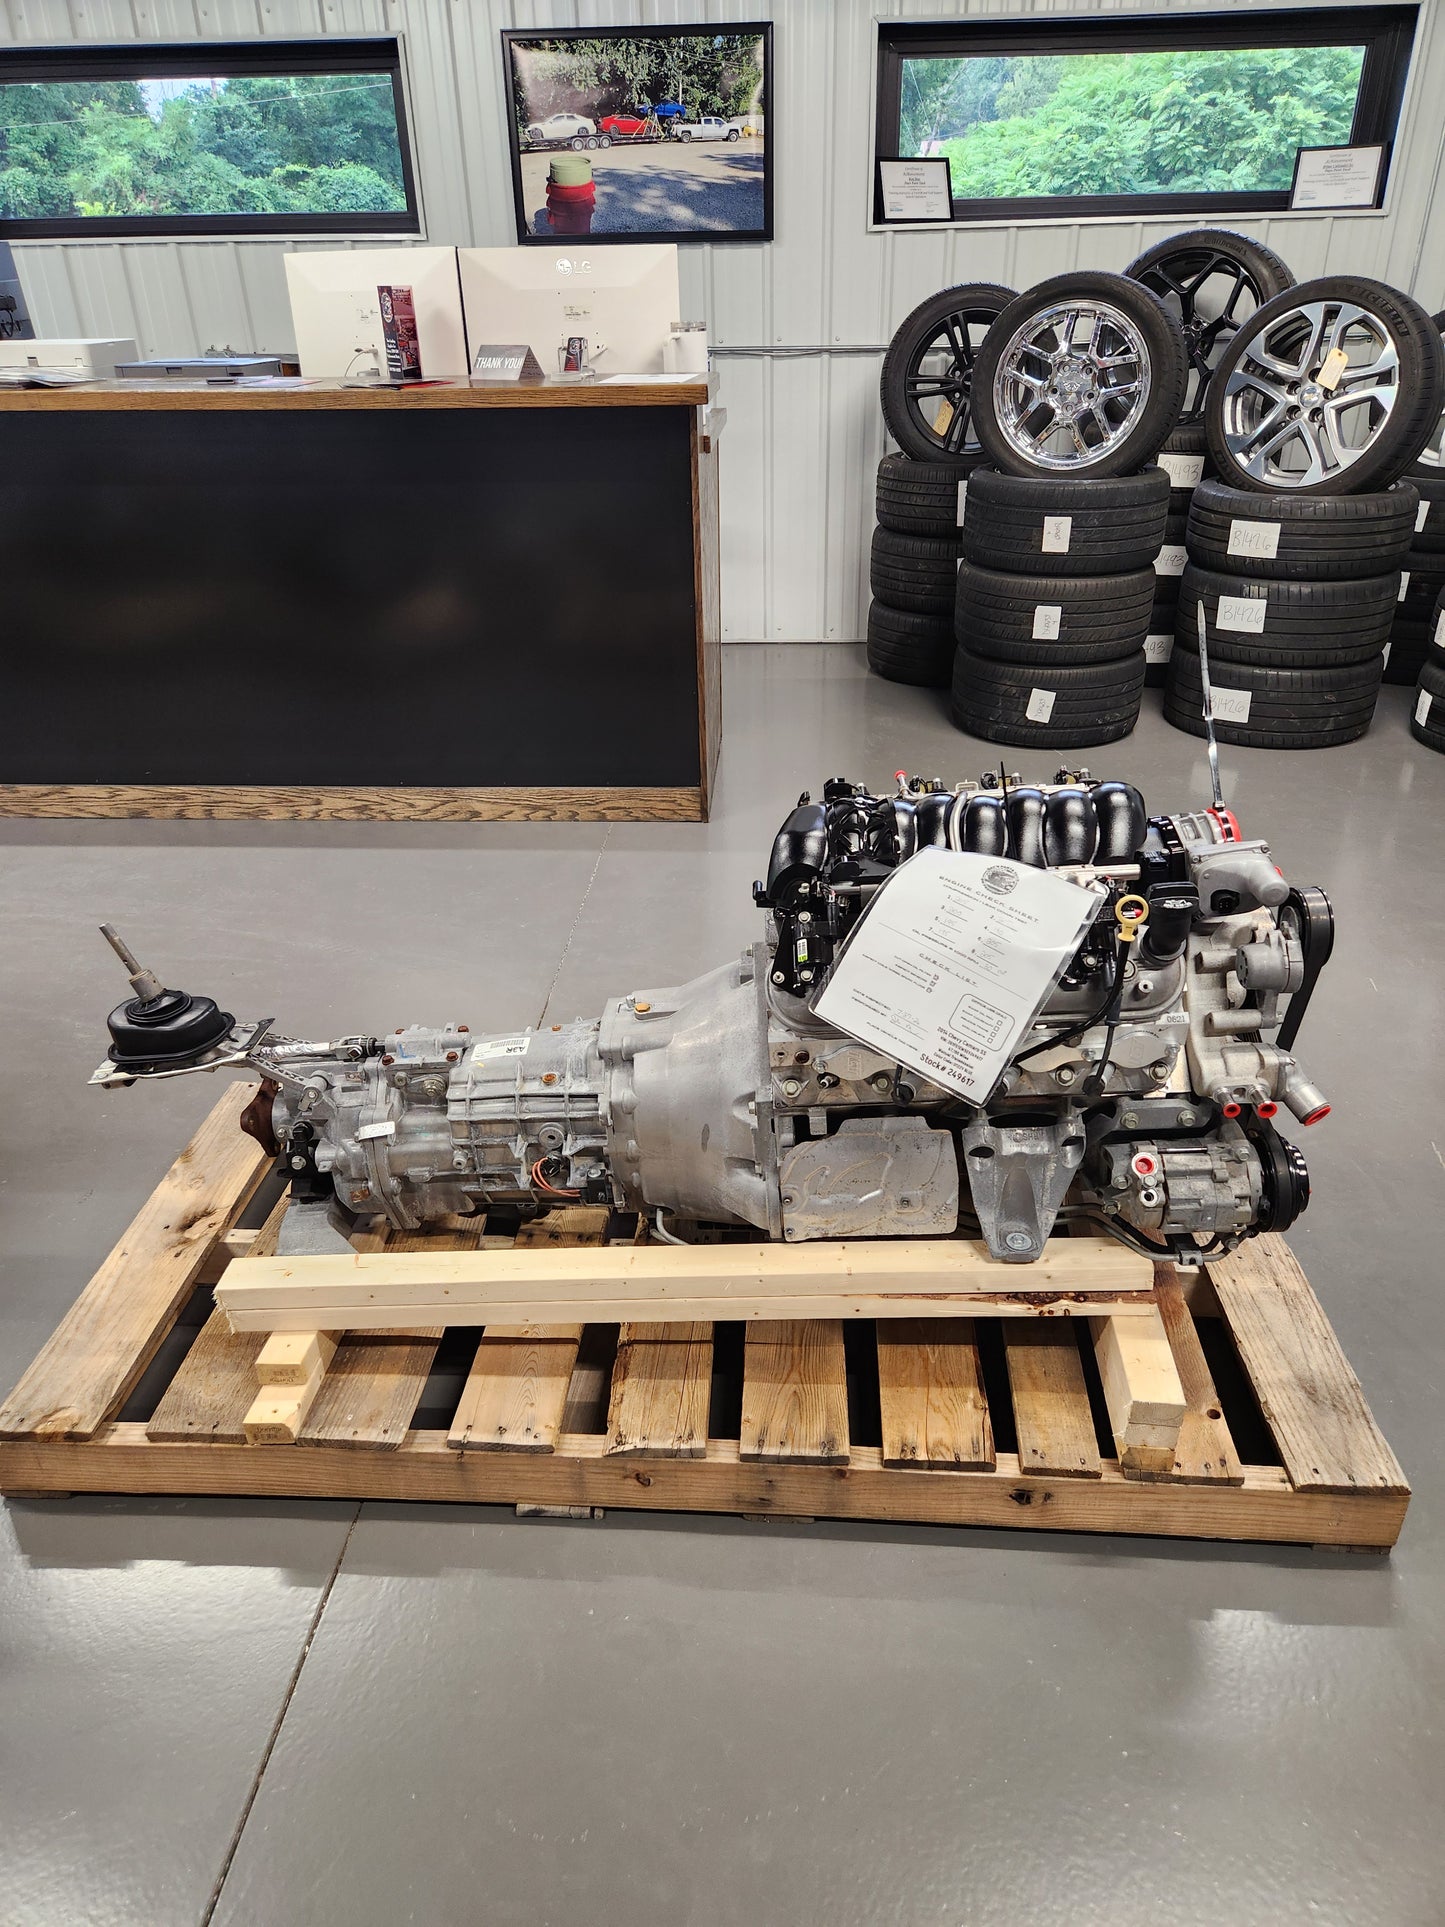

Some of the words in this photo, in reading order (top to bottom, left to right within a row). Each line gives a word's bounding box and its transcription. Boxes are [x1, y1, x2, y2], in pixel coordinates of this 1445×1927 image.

[476, 357, 505, 369] THANK
[1231, 528, 1272, 551] B1426
[1223, 604, 1264, 624] B1426
[974, 890, 1004, 907] CHECK
[1007, 905, 1039, 924] SHEET
[506, 1046, 526, 1054] A3R
[947, 1032, 962, 1043] Chevy
[962, 1040, 980, 1052] Camaro
[937, 1048, 951, 1057] Manual
[920, 1053, 946, 1071] Stock#
[947, 1067, 975, 1087] 249617
